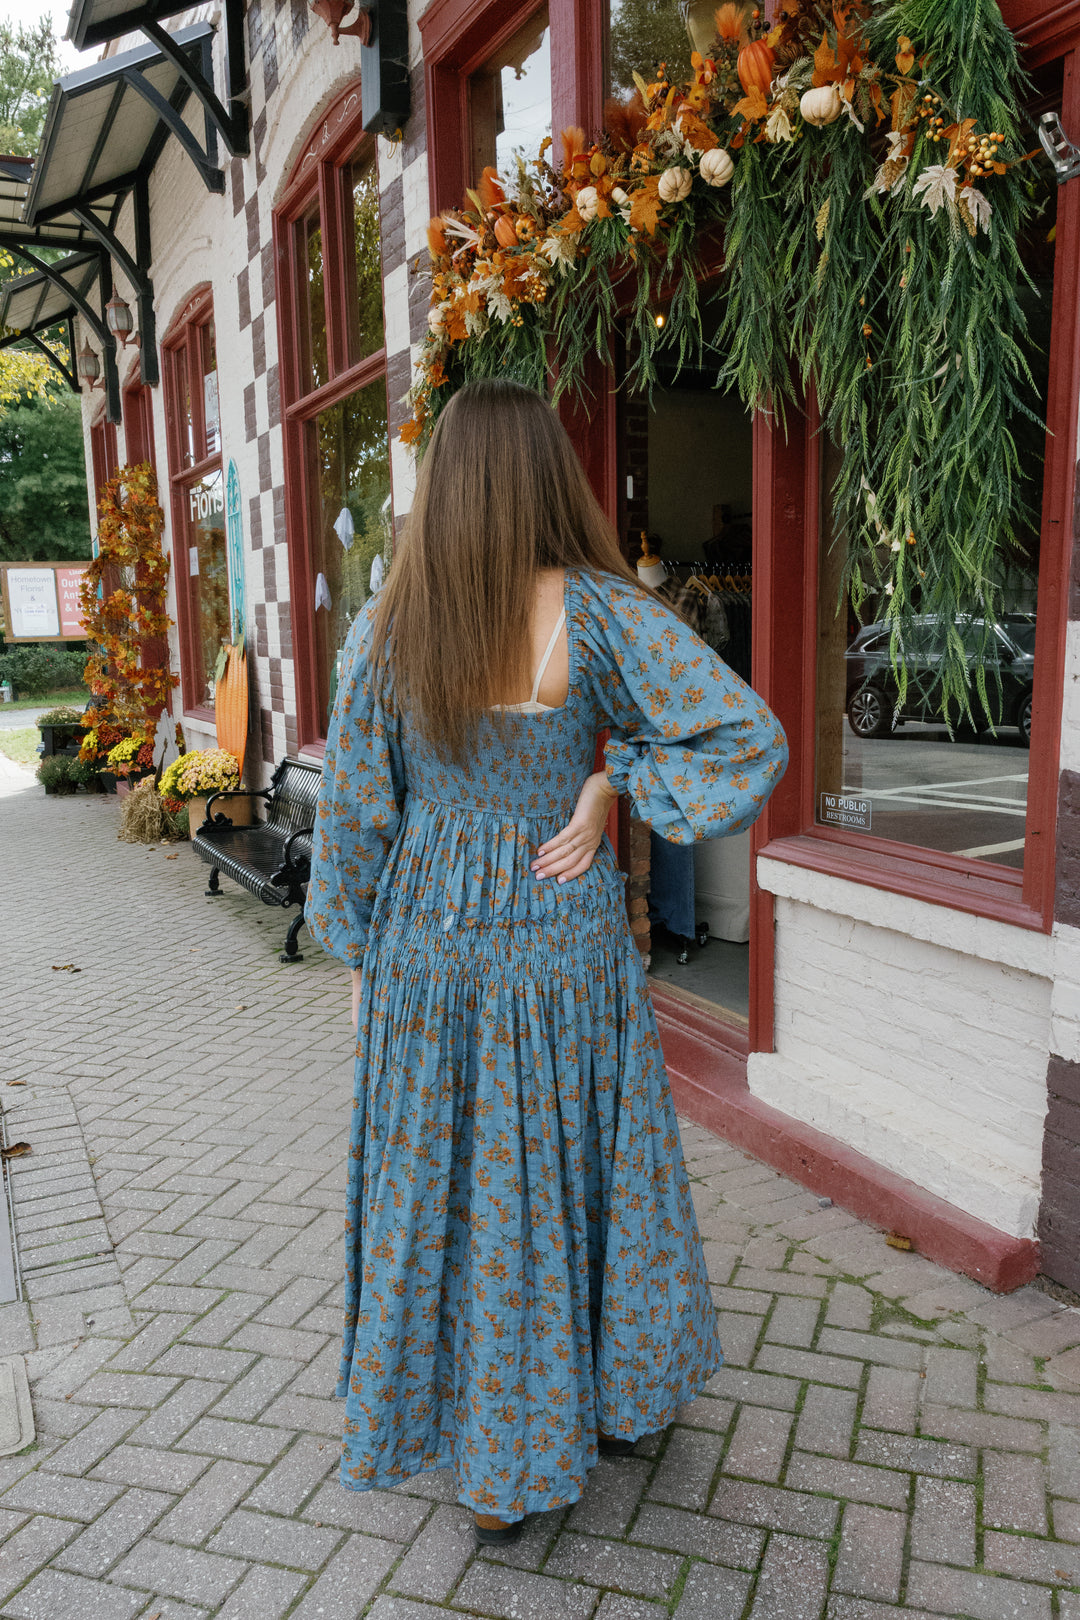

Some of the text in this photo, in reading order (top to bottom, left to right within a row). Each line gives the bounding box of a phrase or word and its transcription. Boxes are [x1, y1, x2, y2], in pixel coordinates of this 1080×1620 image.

[65, 603, 73, 612] &
[825, 796, 866, 812] NO PUBLIC
[826, 811, 866, 825] RESTROOMS
